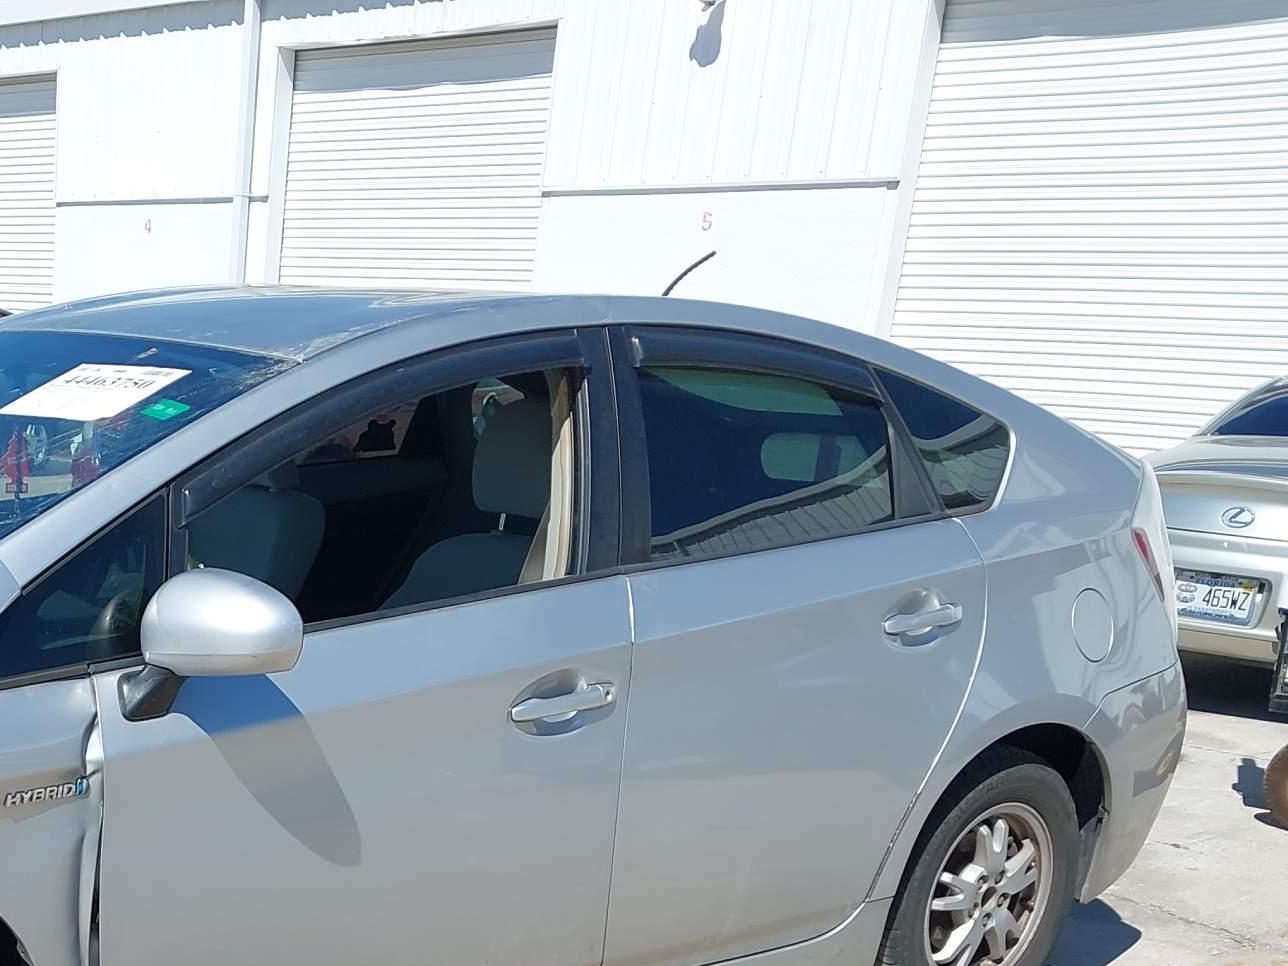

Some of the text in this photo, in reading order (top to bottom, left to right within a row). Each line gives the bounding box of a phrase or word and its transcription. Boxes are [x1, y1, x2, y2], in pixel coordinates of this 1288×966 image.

[144, 218, 152, 234] 4
[701, 211, 713, 231] 5
[1202, 587, 1251, 611] 465WZ
[4, 782, 76, 808] HYBRID
